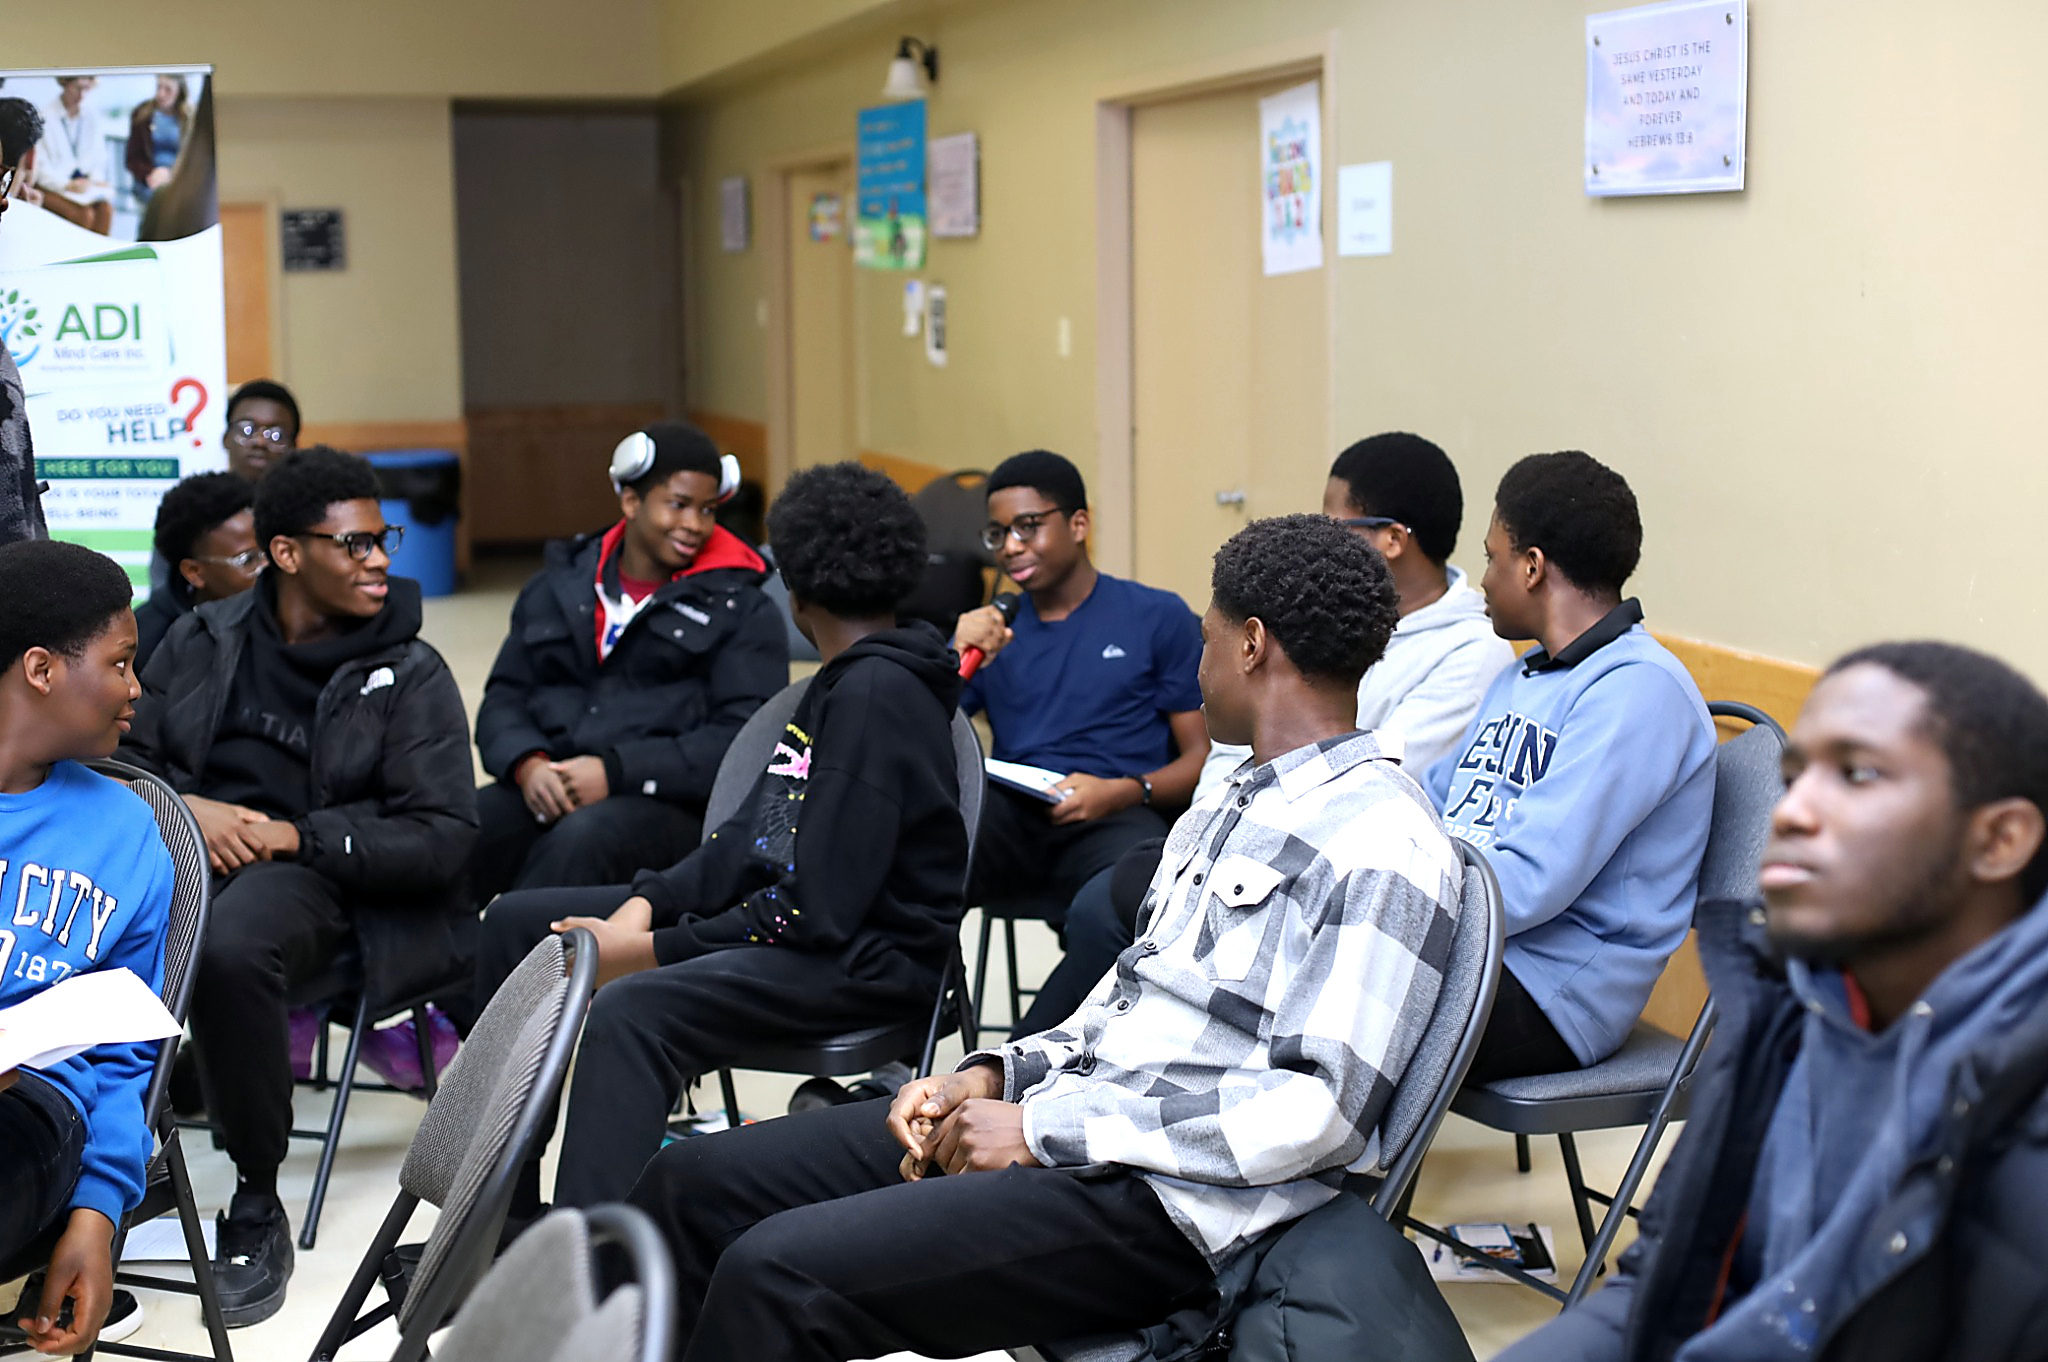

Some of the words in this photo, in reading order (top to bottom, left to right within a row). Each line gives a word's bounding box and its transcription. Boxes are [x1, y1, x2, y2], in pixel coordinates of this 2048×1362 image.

[1612, 51, 1640, 65] JESUS
[1644, 45, 1677, 61] CHRIST
[1680, 43, 1689, 56] IS
[1692, 40, 1711, 54] THE
[1621, 71, 1645, 85] SAME
[1649, 64, 1703, 82] YESTERDAY
[1623, 92, 1643, 105] AND
[1645, 89, 1678, 105] TODAY
[1680, 86, 1700, 101] AND
[1639, 110, 1682, 125] FOREVER
[1628, 133, 1673, 148] HEBREWS
[55, 304, 141, 341] ADI
[57, 408, 82, 422] DO
[86, 406, 119, 419] YOU
[124, 403, 167, 417] NEED
[44, 460, 92, 477] HERE
[95, 460, 132, 477] FOR
[134, 460, 173, 476] YOU
[260, 712, 308, 747] TIA
[12, 862, 118, 962] CITY
[14, 951, 82, 986] 187
